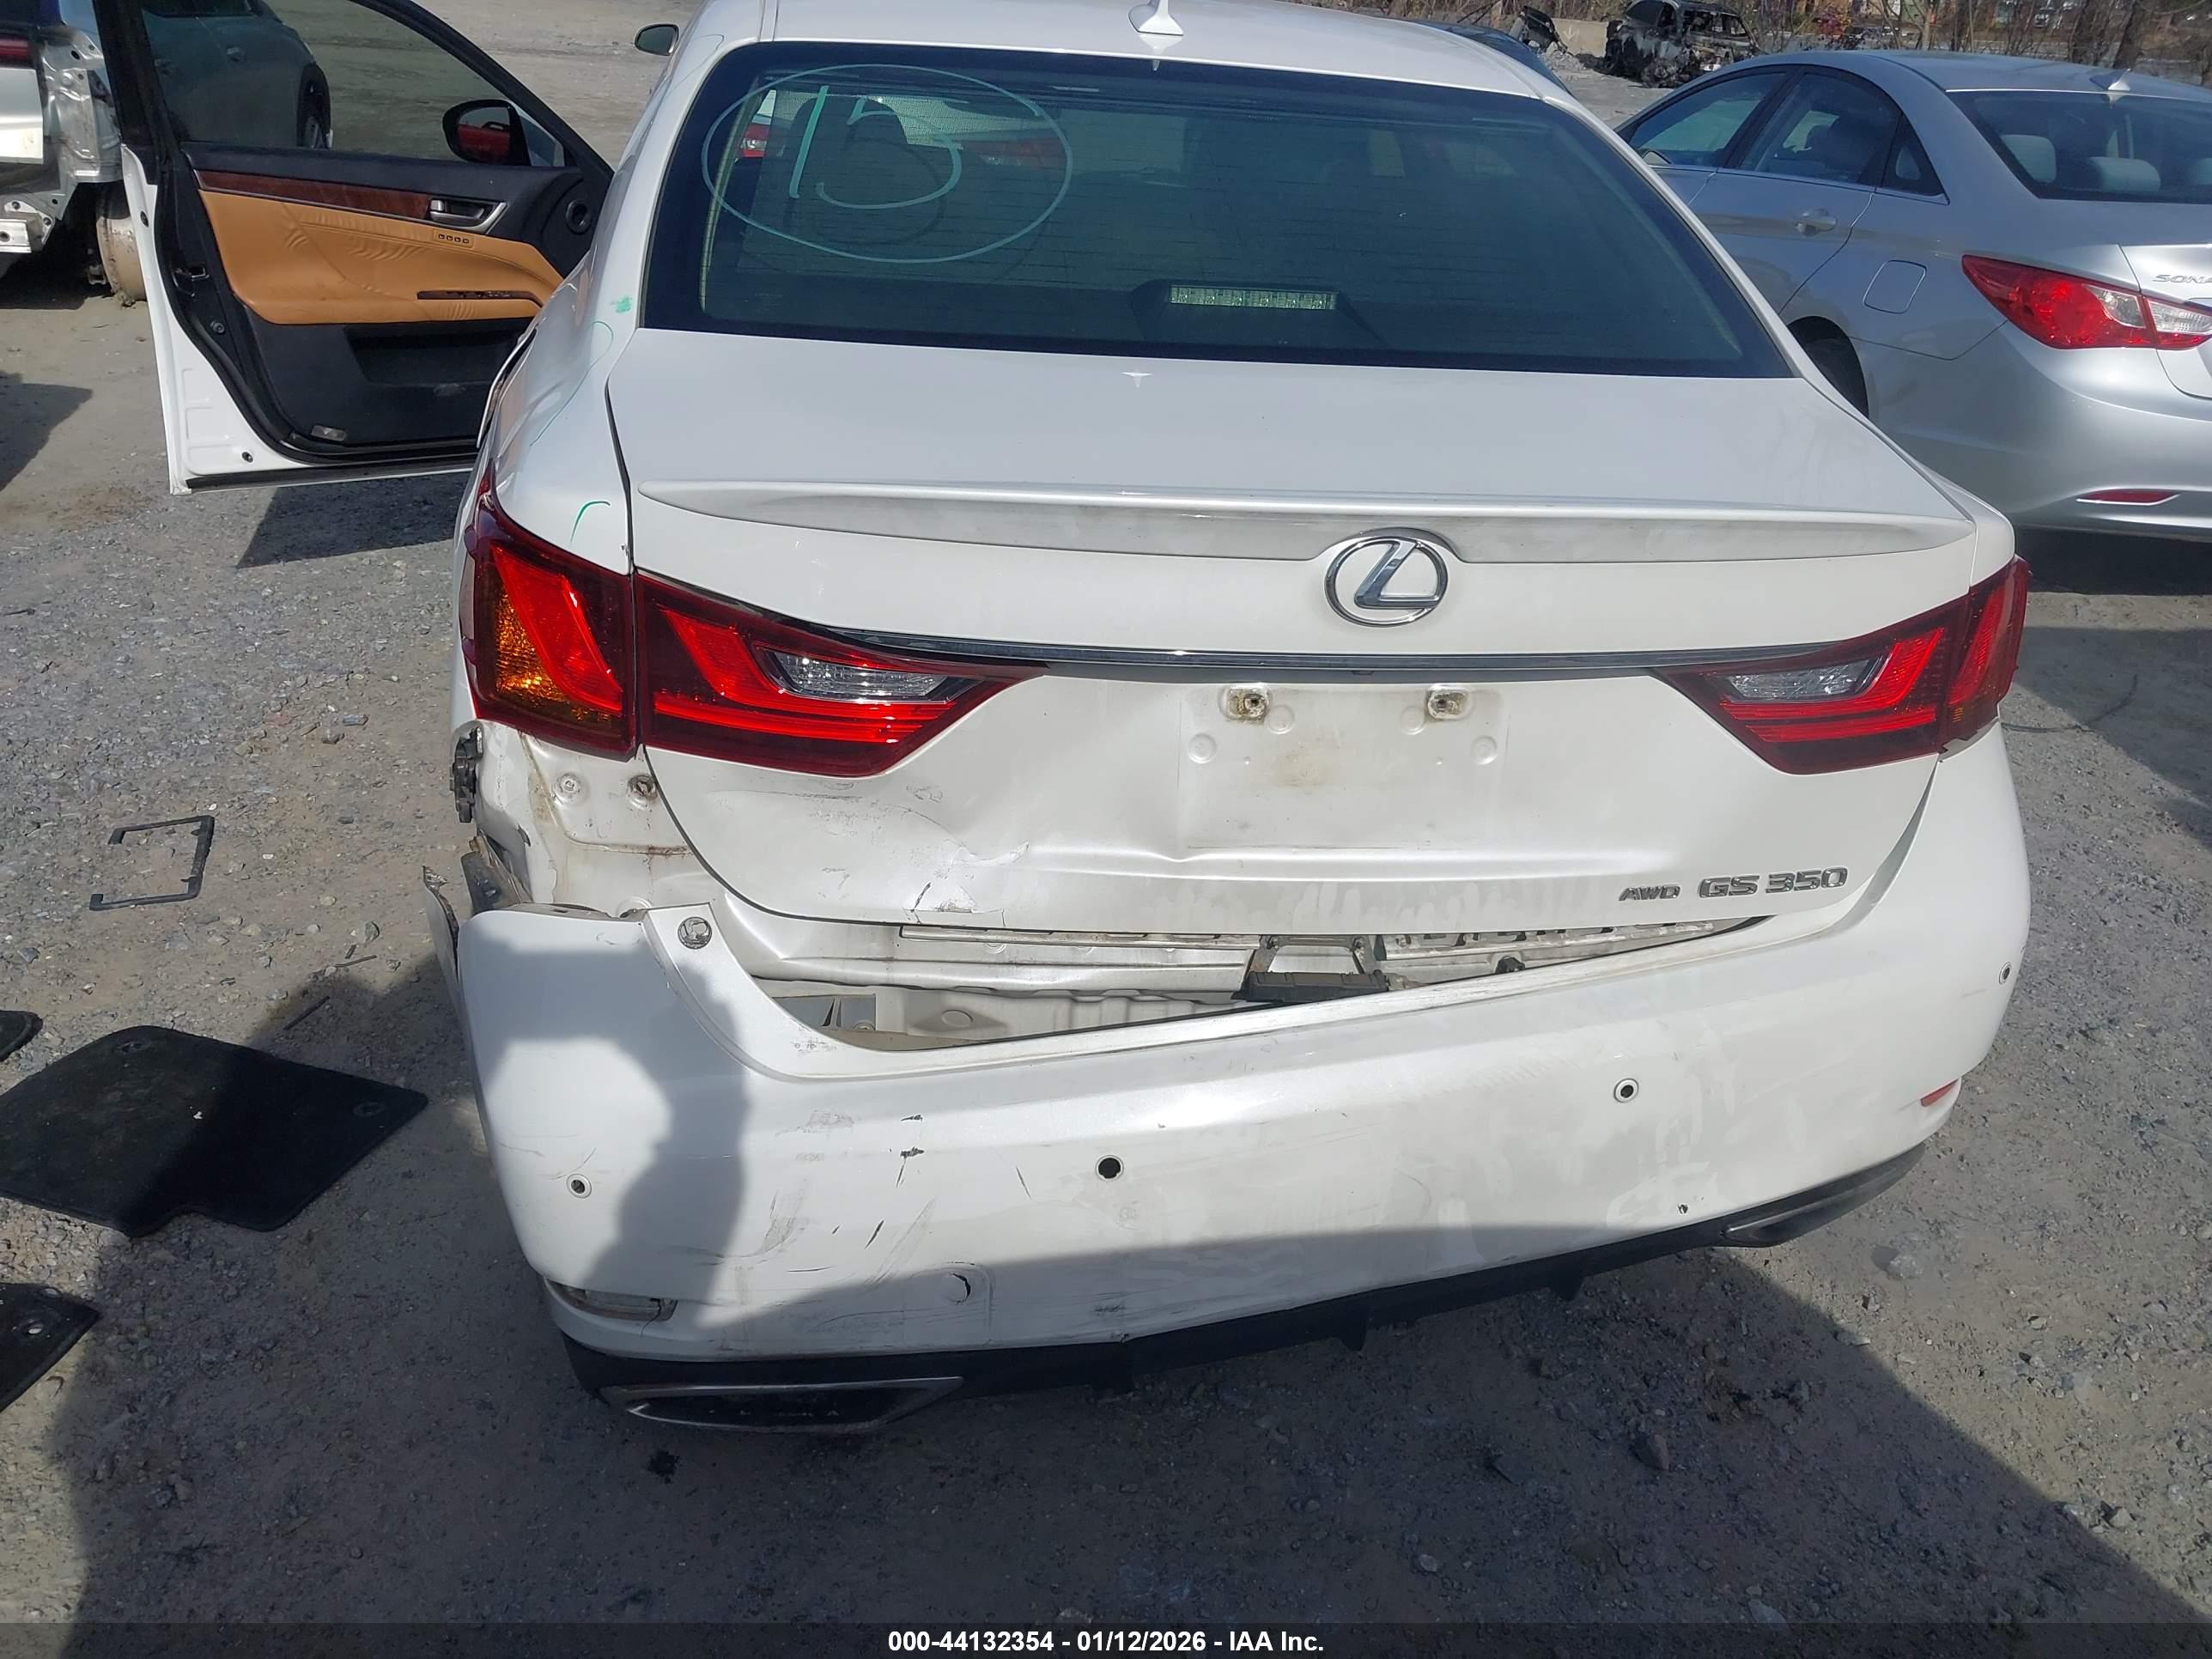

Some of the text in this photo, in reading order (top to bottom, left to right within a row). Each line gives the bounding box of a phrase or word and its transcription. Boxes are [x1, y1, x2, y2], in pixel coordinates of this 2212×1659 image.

[1619, 866, 1848, 902] AWD GS 350
